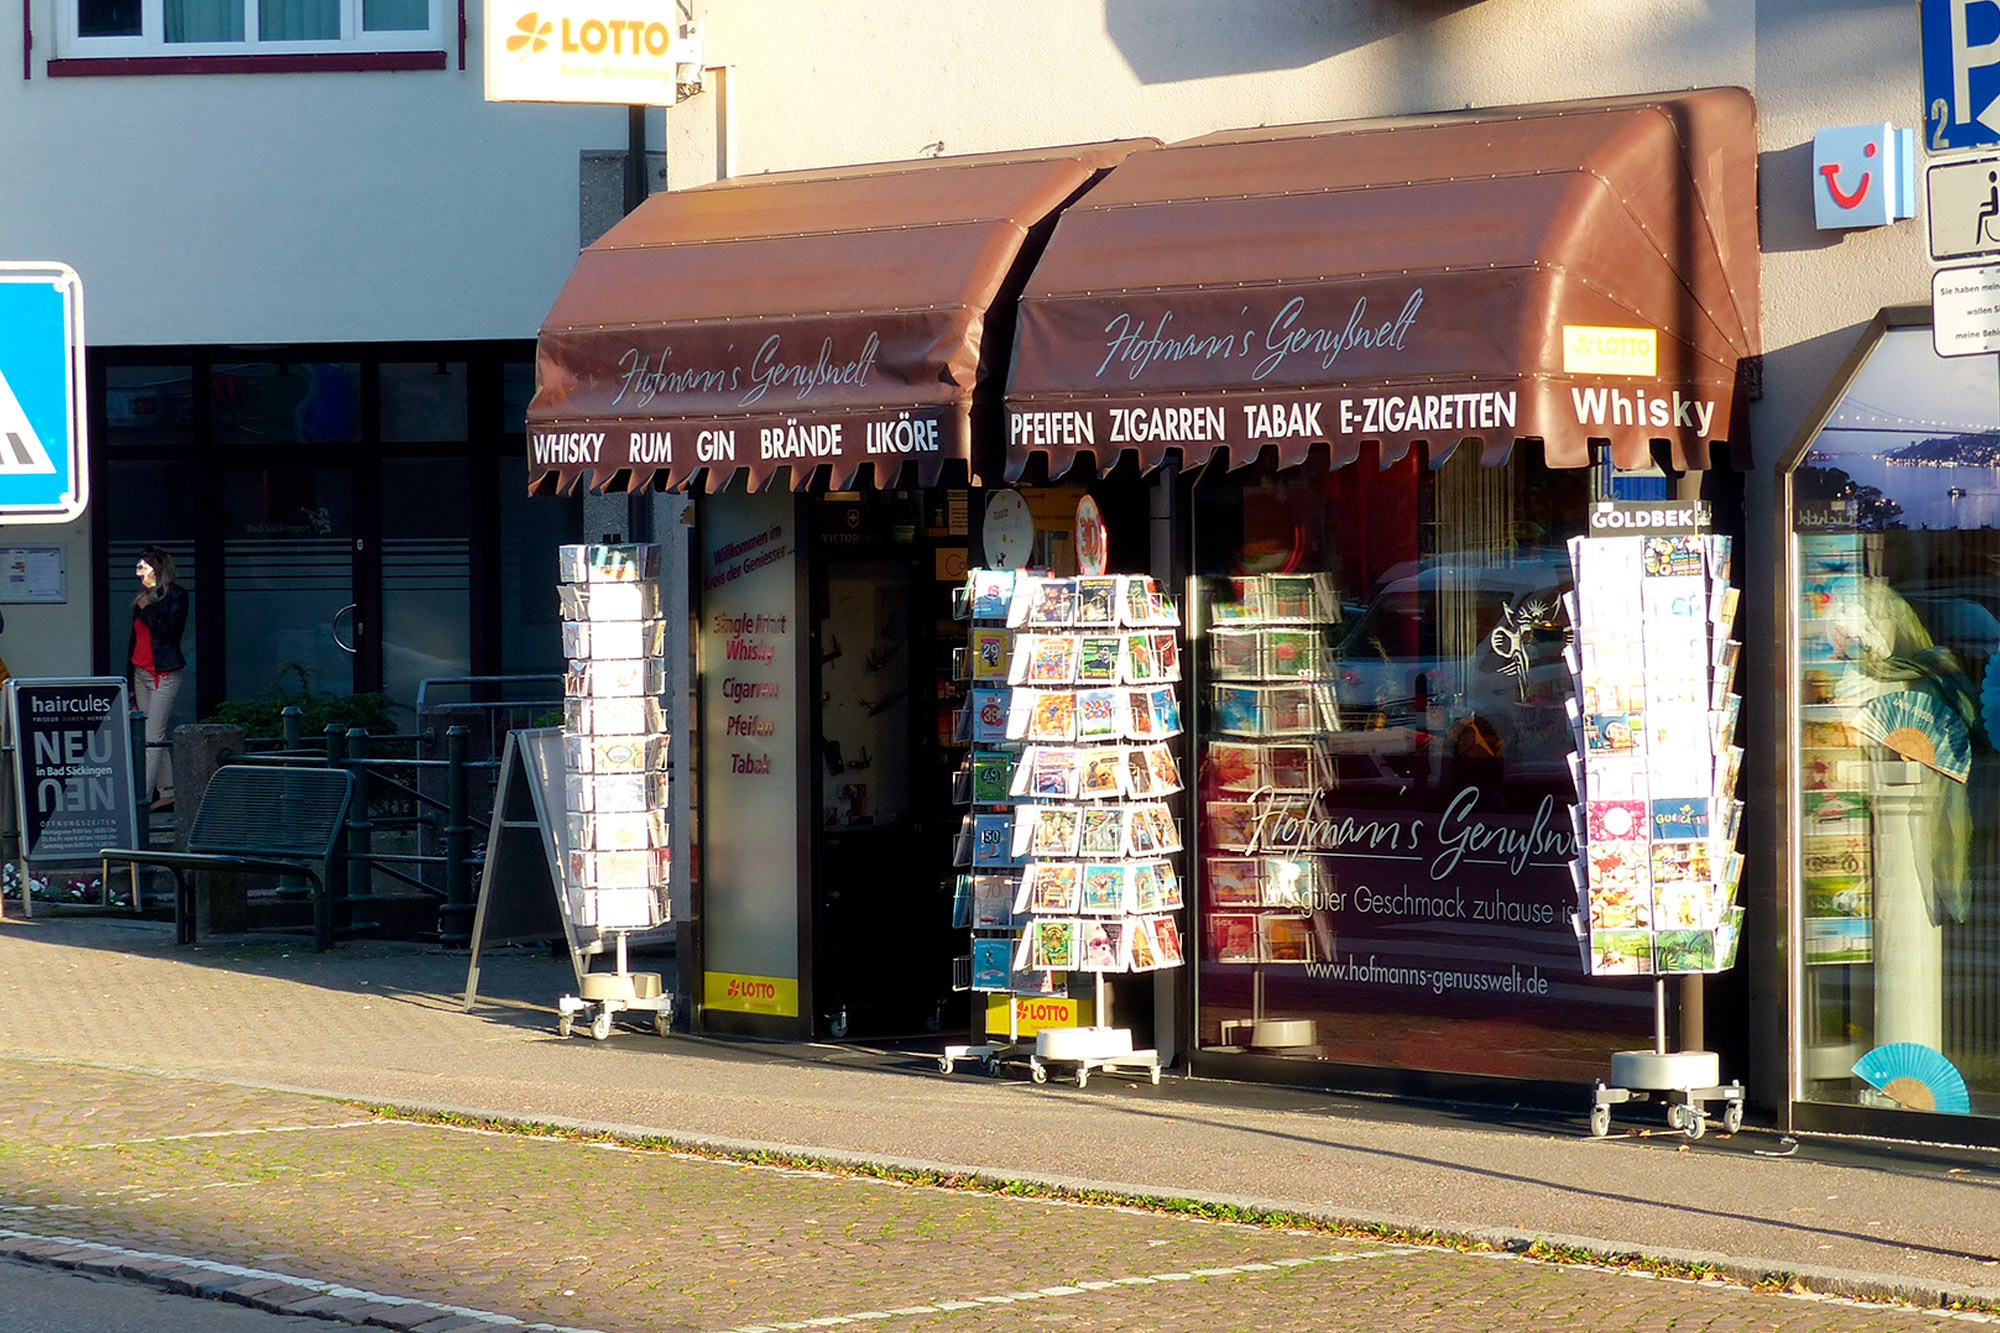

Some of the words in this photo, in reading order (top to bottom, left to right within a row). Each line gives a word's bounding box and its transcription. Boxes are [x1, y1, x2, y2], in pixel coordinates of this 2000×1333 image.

[561, 18, 669, 56] LOTTO
[1931, 98, 1949, 149] 2
[1095, 306, 1255, 381] Hofmann's
[1252, 288, 1424, 381] Genußwelt
[1597, 336, 1649, 356] LOTTO
[612, 343, 741, 408] Hofmann's
[738, 331, 880, 408] Genußwelt
[1011, 411, 1095, 445] PFEIFEN
[1109, 407, 1226, 442] ZIGARREN
[1244, 403, 1323, 438] TABAK
[1340, 391, 1517, 434] E-ZIGARETTEN
[1571, 387, 1715, 437] Whisky
[533, 433, 606, 464] WHISKY
[629, 432, 672, 463] RUM
[696, 430, 735, 462] GIN
[760, 418, 843, 459] BRÄNDE
[866, 412, 939, 454] LIKÖRE
[1591, 510, 1696, 528] GOLDBEK
[714, 534, 768, 566] Willkommen
[770, 525, 782, 541] im
[703, 572, 726, 593] Kreis
[727, 566, 742, 582] der
[743, 545, 786, 574] Geniesser
[713, 613, 754, 639] Single
[726, 639, 775, 666] Whisky
[32, 694, 111, 712] haircules
[722, 677, 780, 704] Cigarren
[726, 714, 775, 736] Pfeifen
[34, 730, 112, 764] NEU
[731, 753, 772, 775] Tabak
[36, 767, 45, 776] in
[47, 766, 64, 776] Bad
[66, 766, 112, 777] Säckingen
[1245, 784, 1424, 863] Hofmann's
[984, 882, 1000, 898] 70
[1301, 888, 1348, 918] guter
[1354, 884, 1466, 919] Geschmack
[1473, 889, 1554, 923] zuhause
[742, 981, 775, 999] LOTTO
[1304, 954, 1549, 996] www.hofmanns-genusswelt.de
[1030, 1004, 1069, 1022] LOTTO
